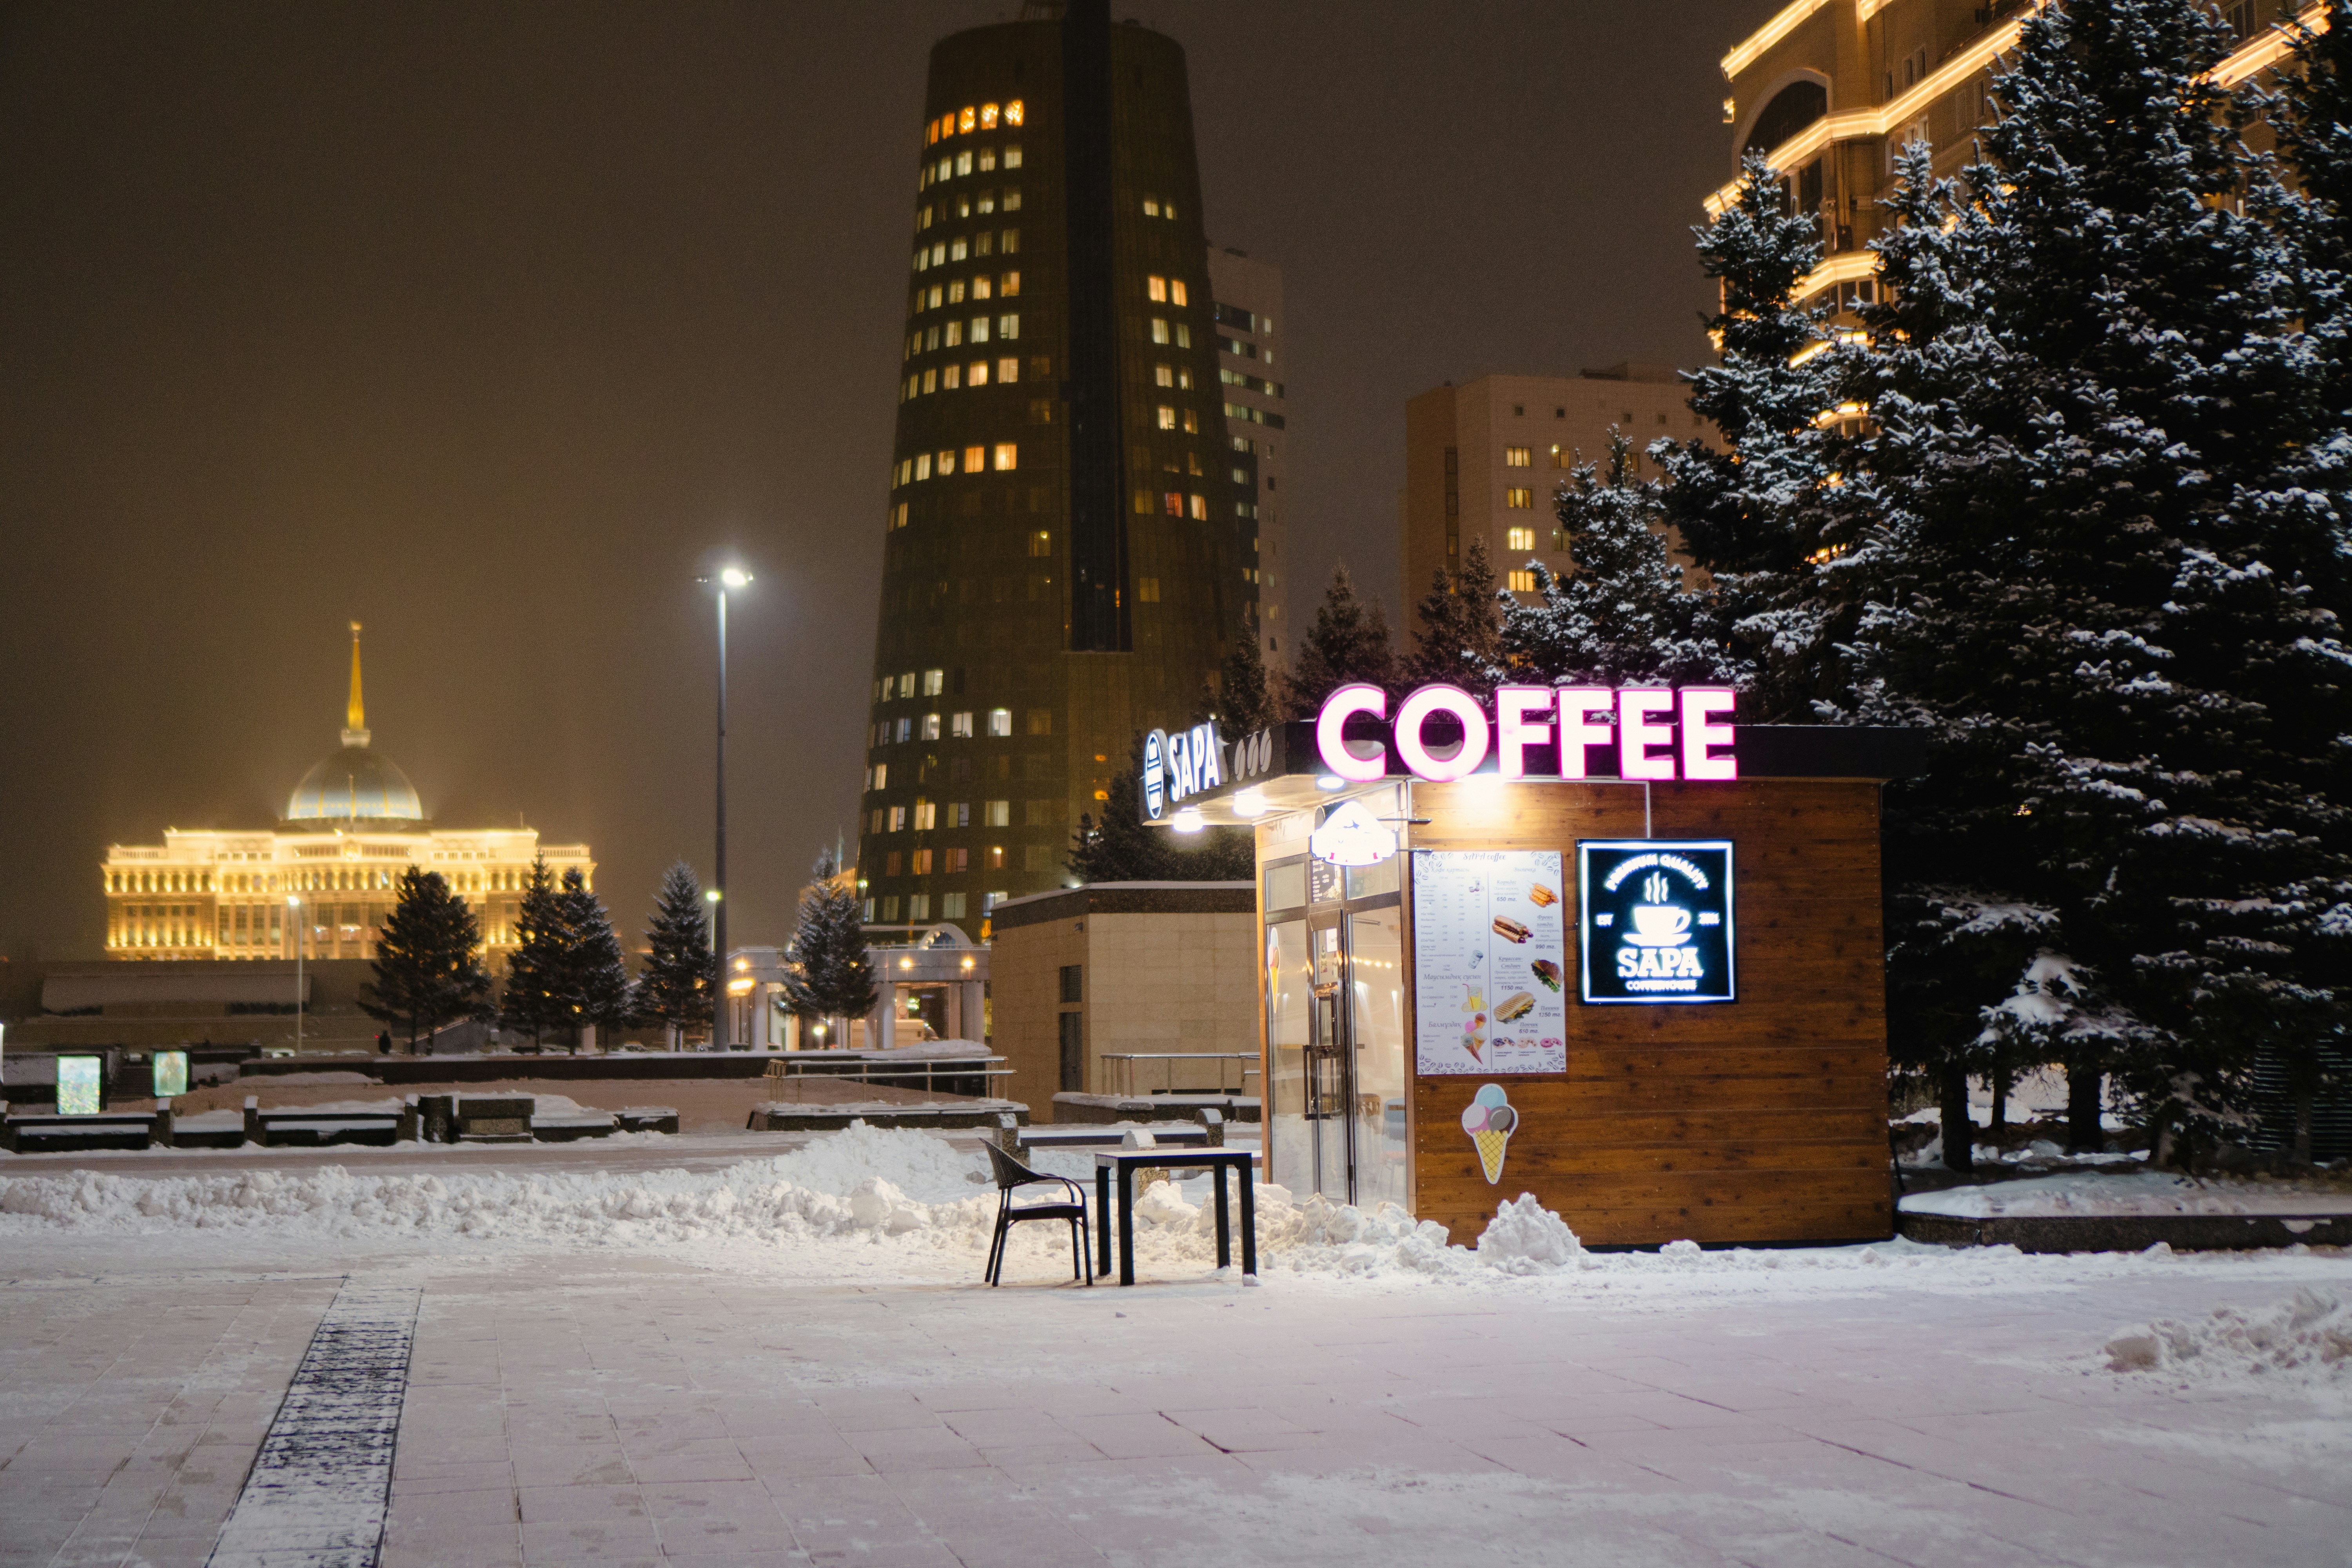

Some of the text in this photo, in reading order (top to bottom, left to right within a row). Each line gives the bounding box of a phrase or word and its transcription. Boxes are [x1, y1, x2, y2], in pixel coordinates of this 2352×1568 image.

[1318, 684, 1738, 782] COFFEE
[1169, 722, 1220, 802] SAPA
[1487, 853, 1506, 862] coffee
[1606, 853, 1708, 891] PREMIUM QUALITY
[1617, 947, 1703, 977] SAPA
[1626, 979, 1697, 991] COFFEEHOUSE
